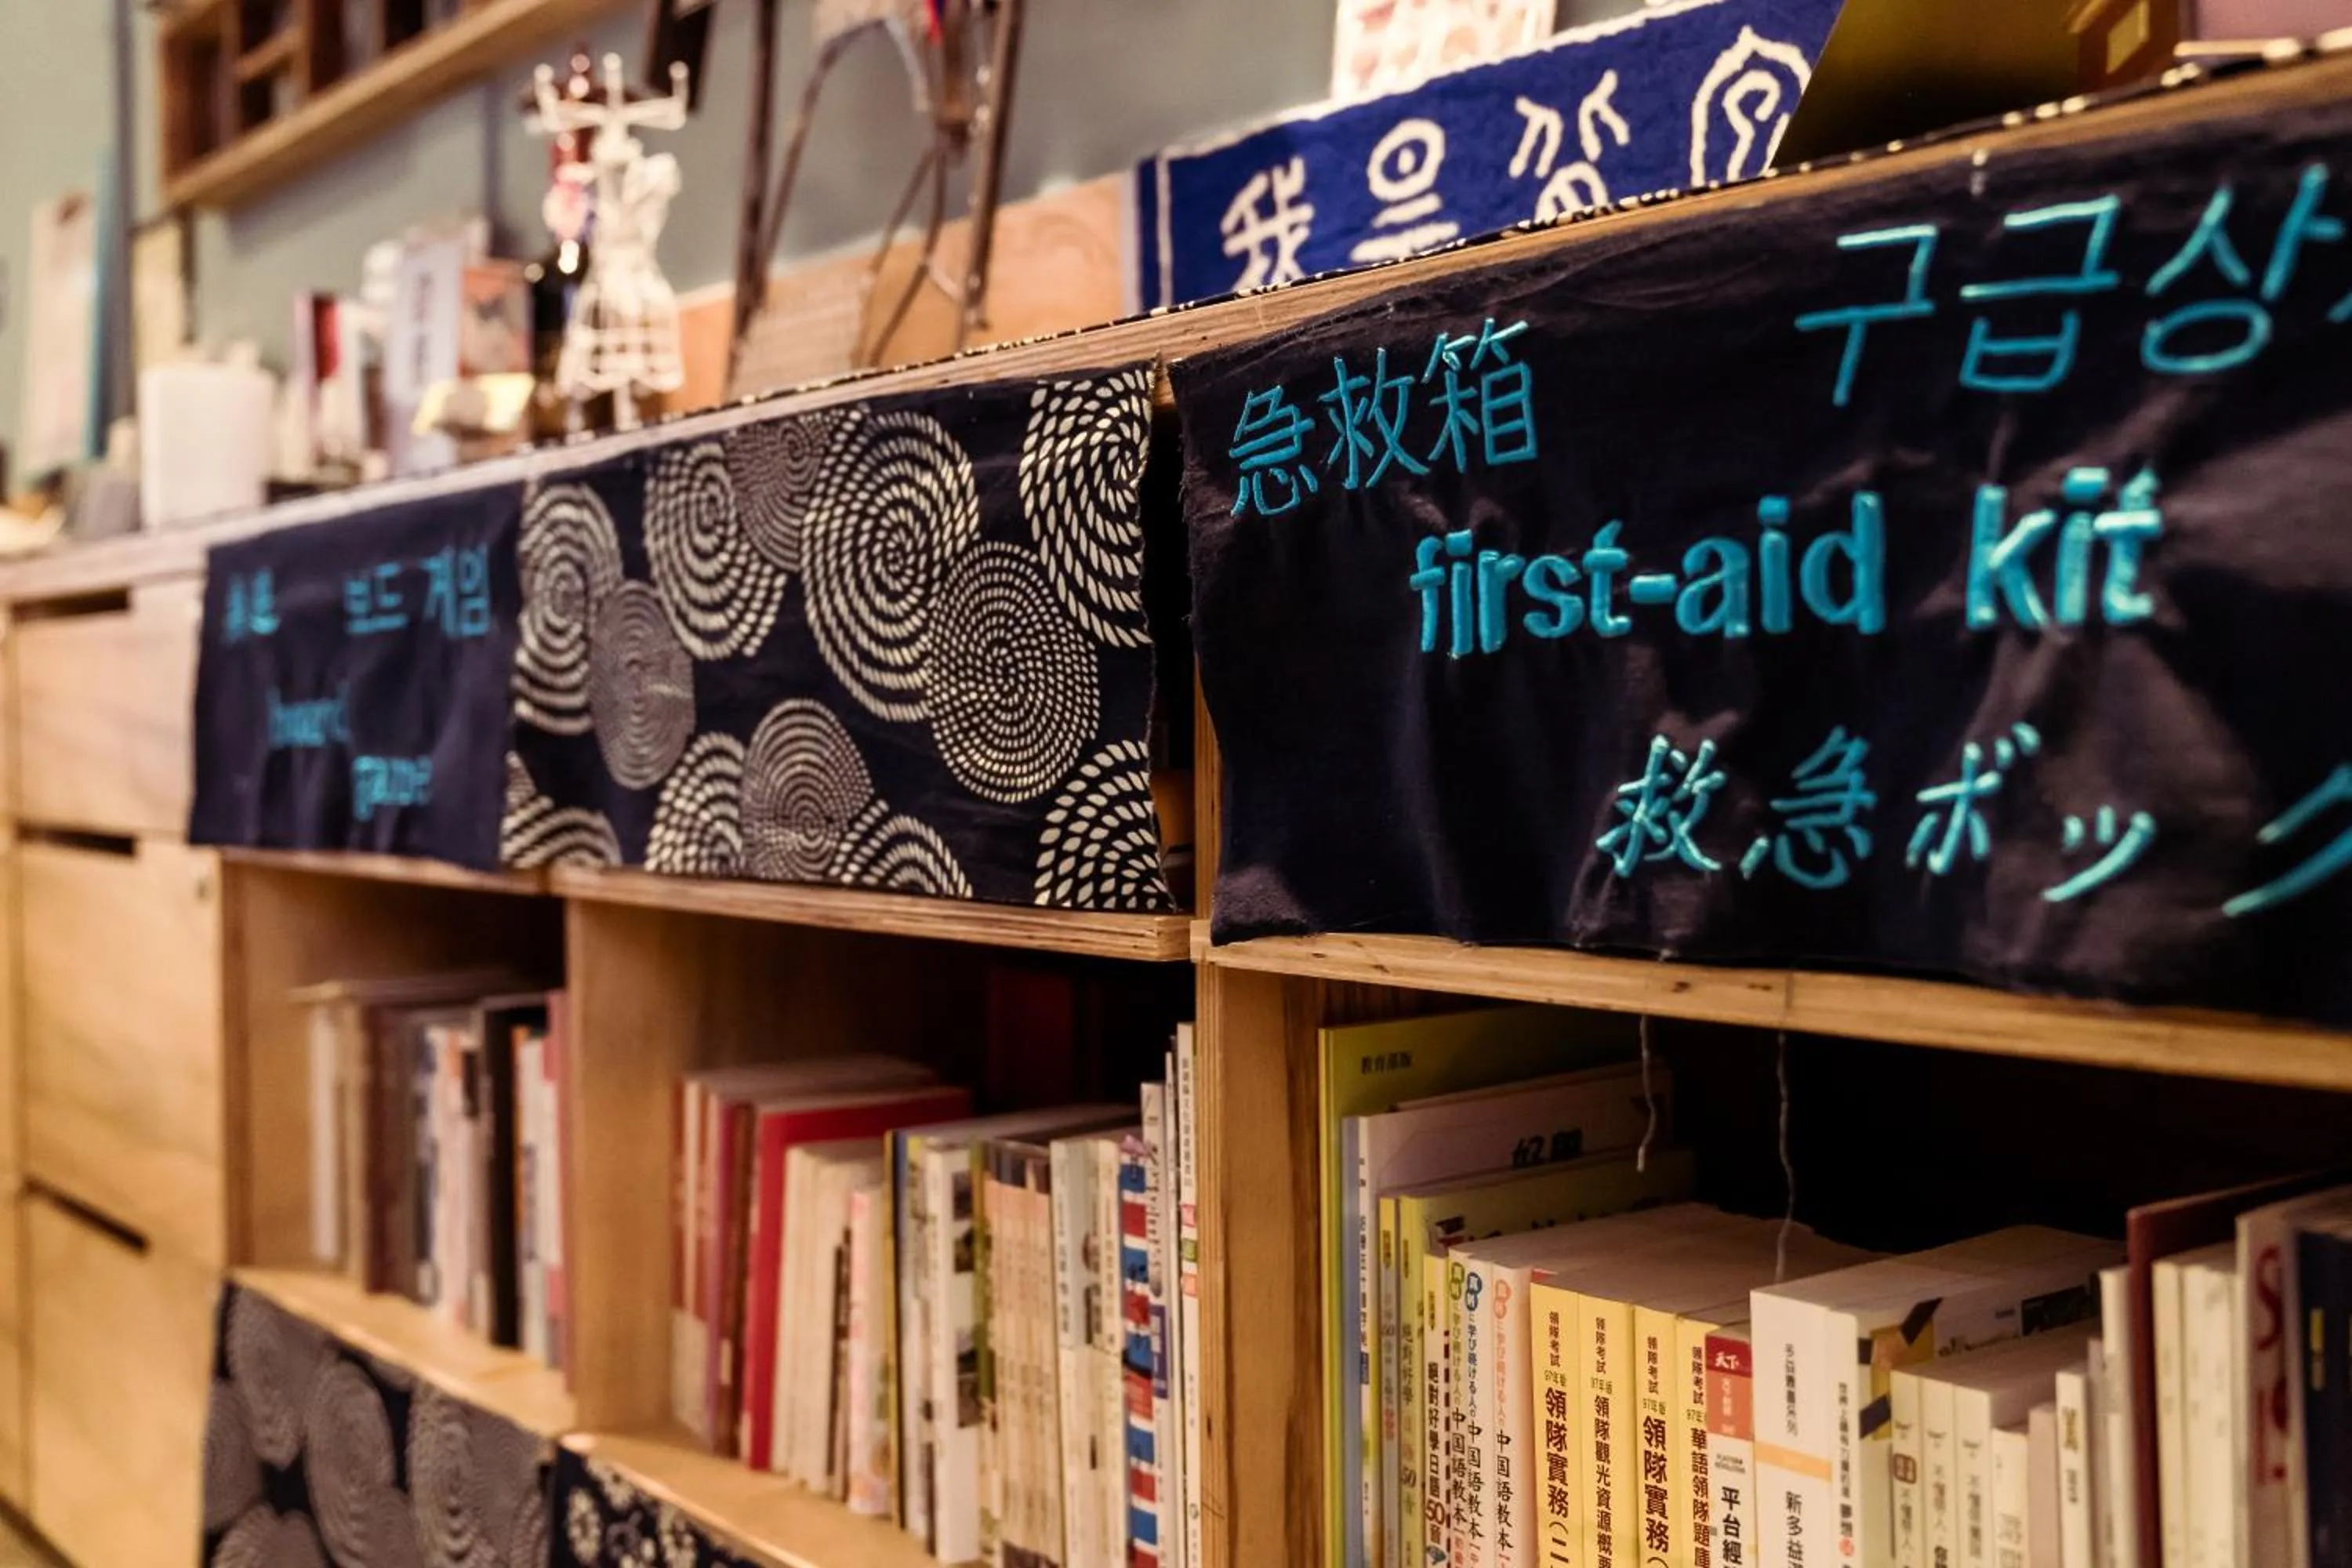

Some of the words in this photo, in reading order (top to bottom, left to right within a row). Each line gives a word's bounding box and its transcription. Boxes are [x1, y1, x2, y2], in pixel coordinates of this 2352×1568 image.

[1794, 162, 2352, 406] 구급상
[1229, 317, 1538, 517] 急救箱
[1410, 490, 1886, 660] first-aid
[1545, 1387, 1570, 1568] 領隊實務(二
[1721, 1486, 1744, 1568] 平台經
